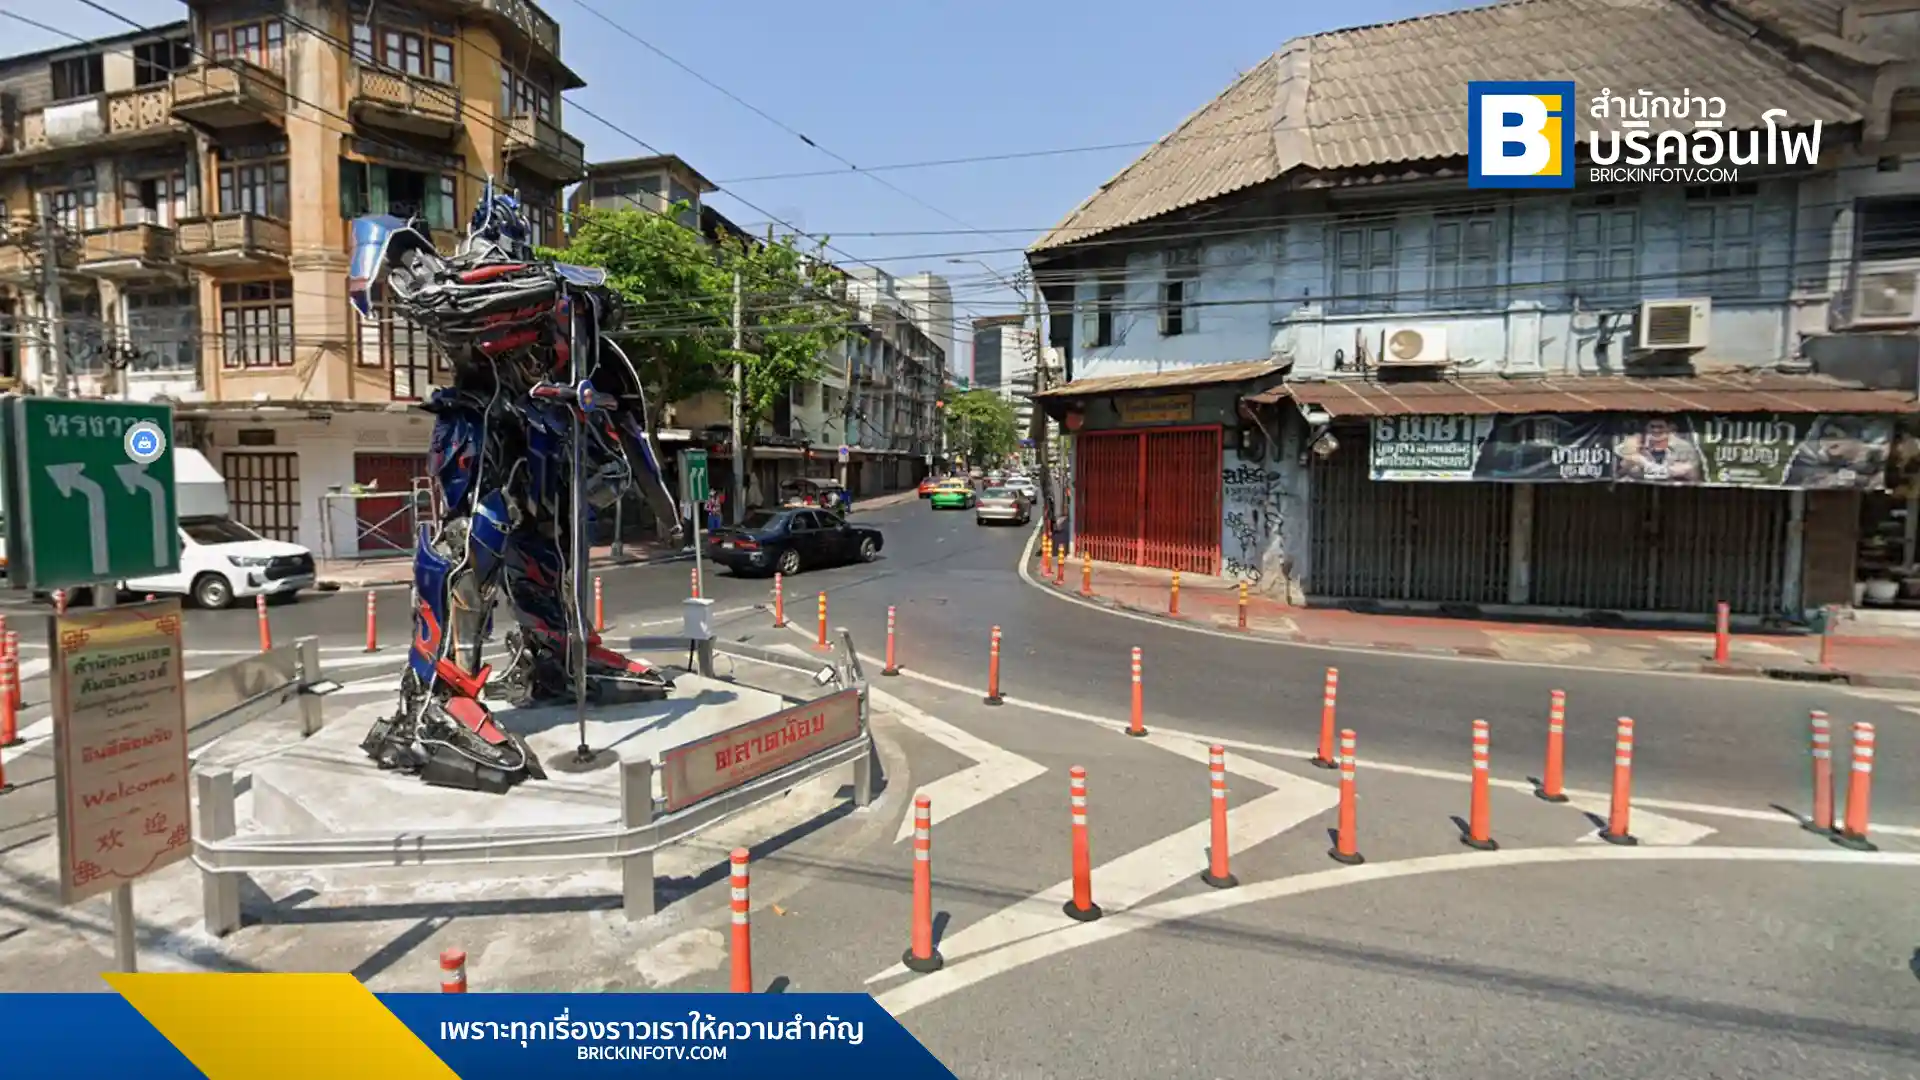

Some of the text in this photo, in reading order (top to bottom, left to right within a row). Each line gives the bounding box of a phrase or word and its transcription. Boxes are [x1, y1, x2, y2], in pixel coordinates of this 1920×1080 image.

[716, 712, 825, 772] ตลาดน้อย
[82, 771, 176, 808] Welcome
